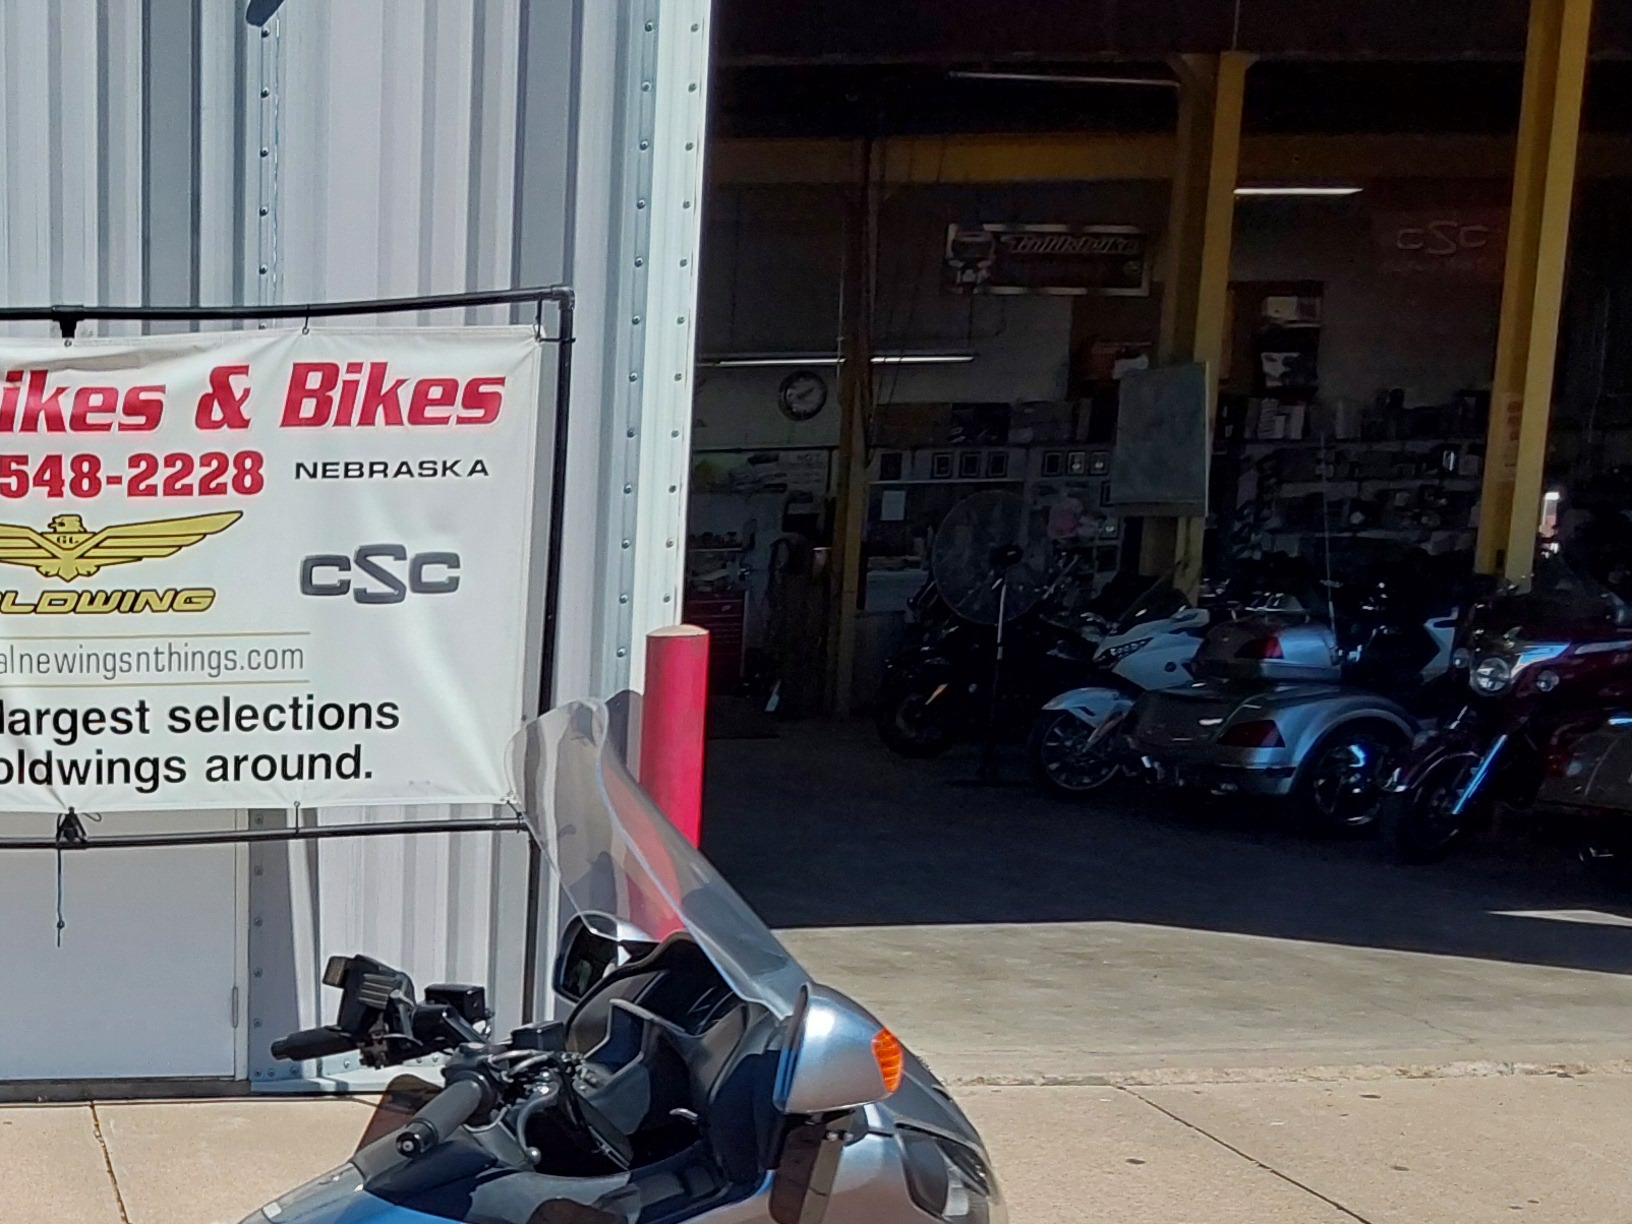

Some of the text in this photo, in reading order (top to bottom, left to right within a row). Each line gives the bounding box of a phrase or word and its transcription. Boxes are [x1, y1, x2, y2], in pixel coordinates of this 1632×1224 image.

[194, 363, 252, 431] &
[279, 361, 507, 428] Bikes
[295, 459, 490, 480] NEBRASKA
[167, 693, 400, 735] selections
[205, 744, 373, 783] around.
